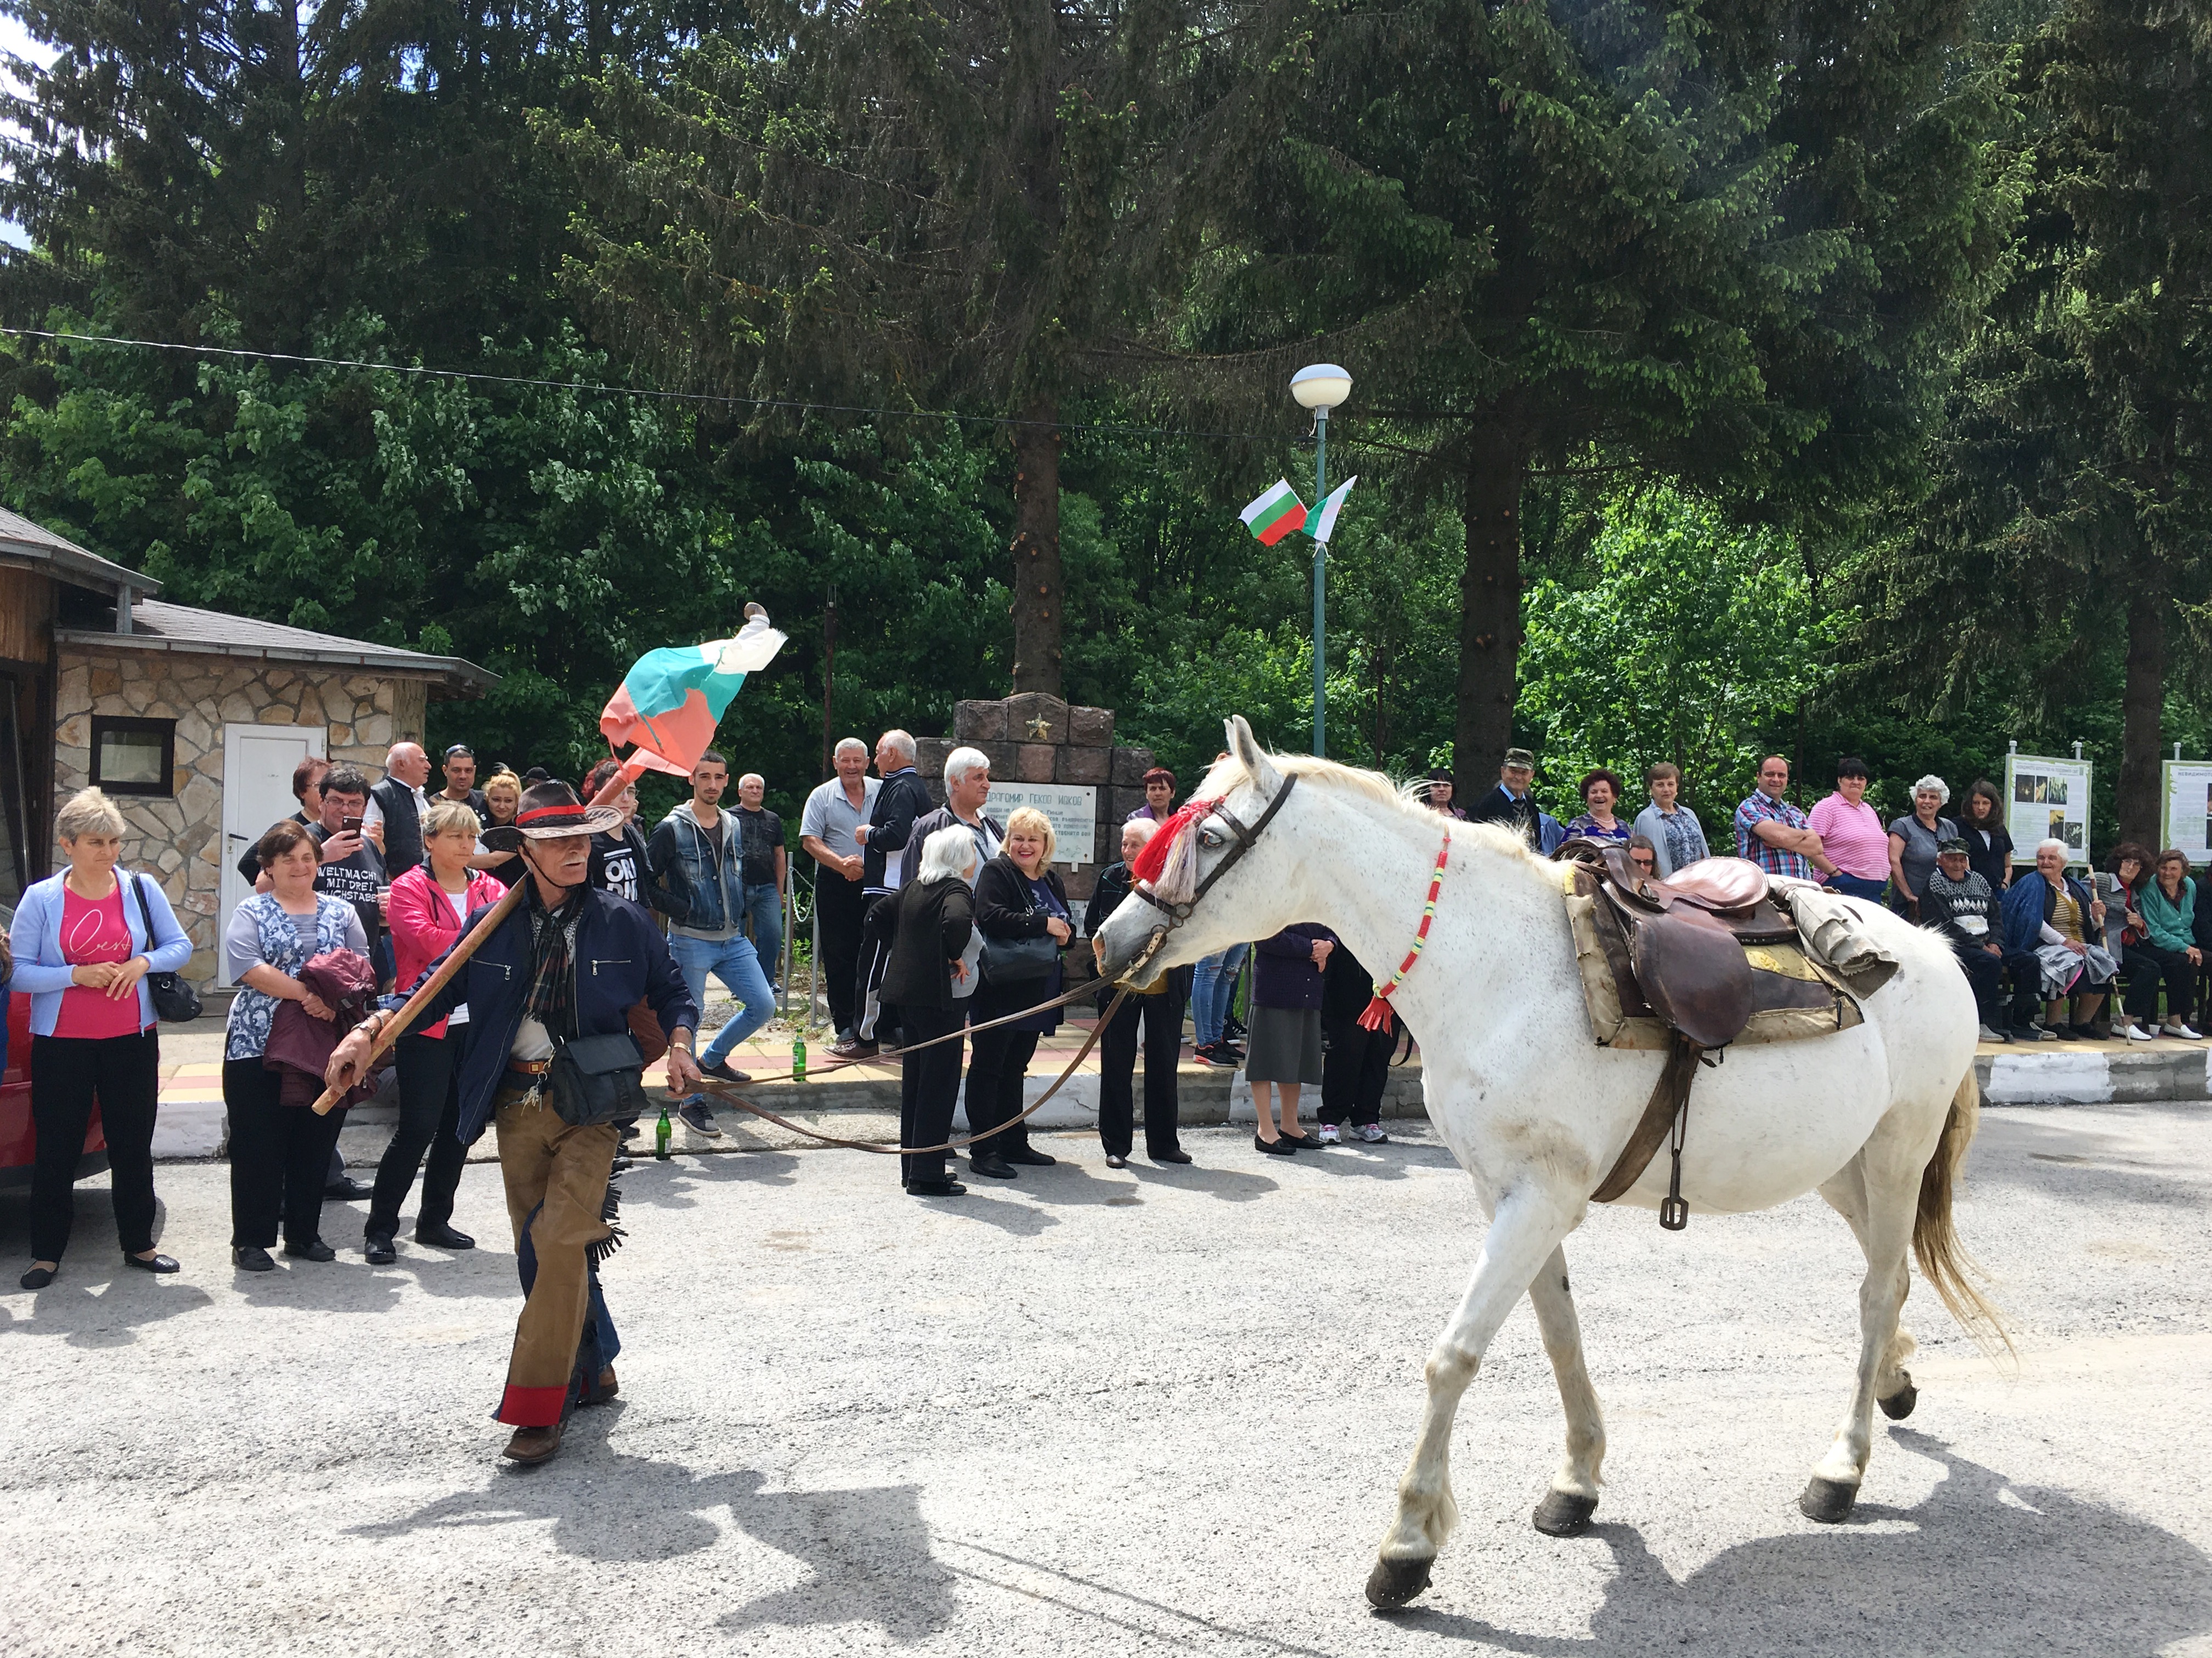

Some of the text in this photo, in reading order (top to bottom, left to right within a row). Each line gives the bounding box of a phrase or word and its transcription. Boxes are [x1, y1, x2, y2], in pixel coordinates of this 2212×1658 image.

[1029, 793, 1052, 804] ГЕКОВ
[1058, 795, 1082, 806] ИВКОВ
[317, 867, 377, 881] WELTMACHT
[326, 878, 374, 891] MIT DREI
